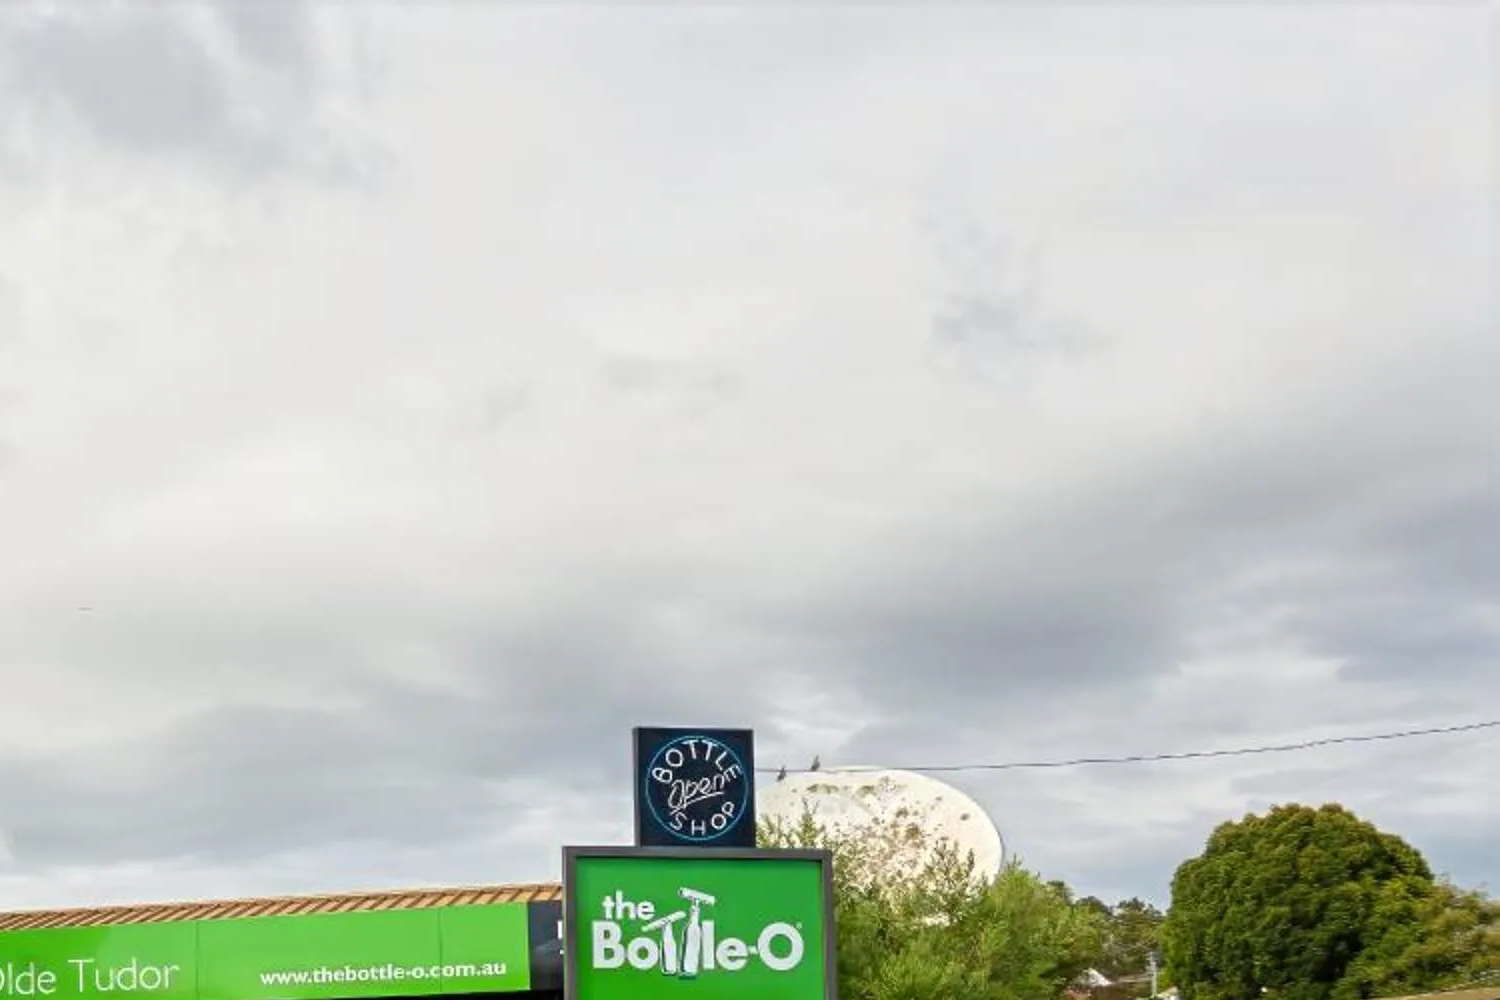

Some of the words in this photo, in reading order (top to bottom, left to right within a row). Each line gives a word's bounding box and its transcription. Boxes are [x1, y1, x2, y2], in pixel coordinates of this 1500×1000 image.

[651, 739, 742, 784] BOTTLE
[667, 774, 725, 809] Open
[669, 801, 736, 836] SHOP
[601, 890, 655, 921] the
[67, 957, 180, 994] Tudor
[259, 961, 507, 985] www.thebottle-o.com.au
